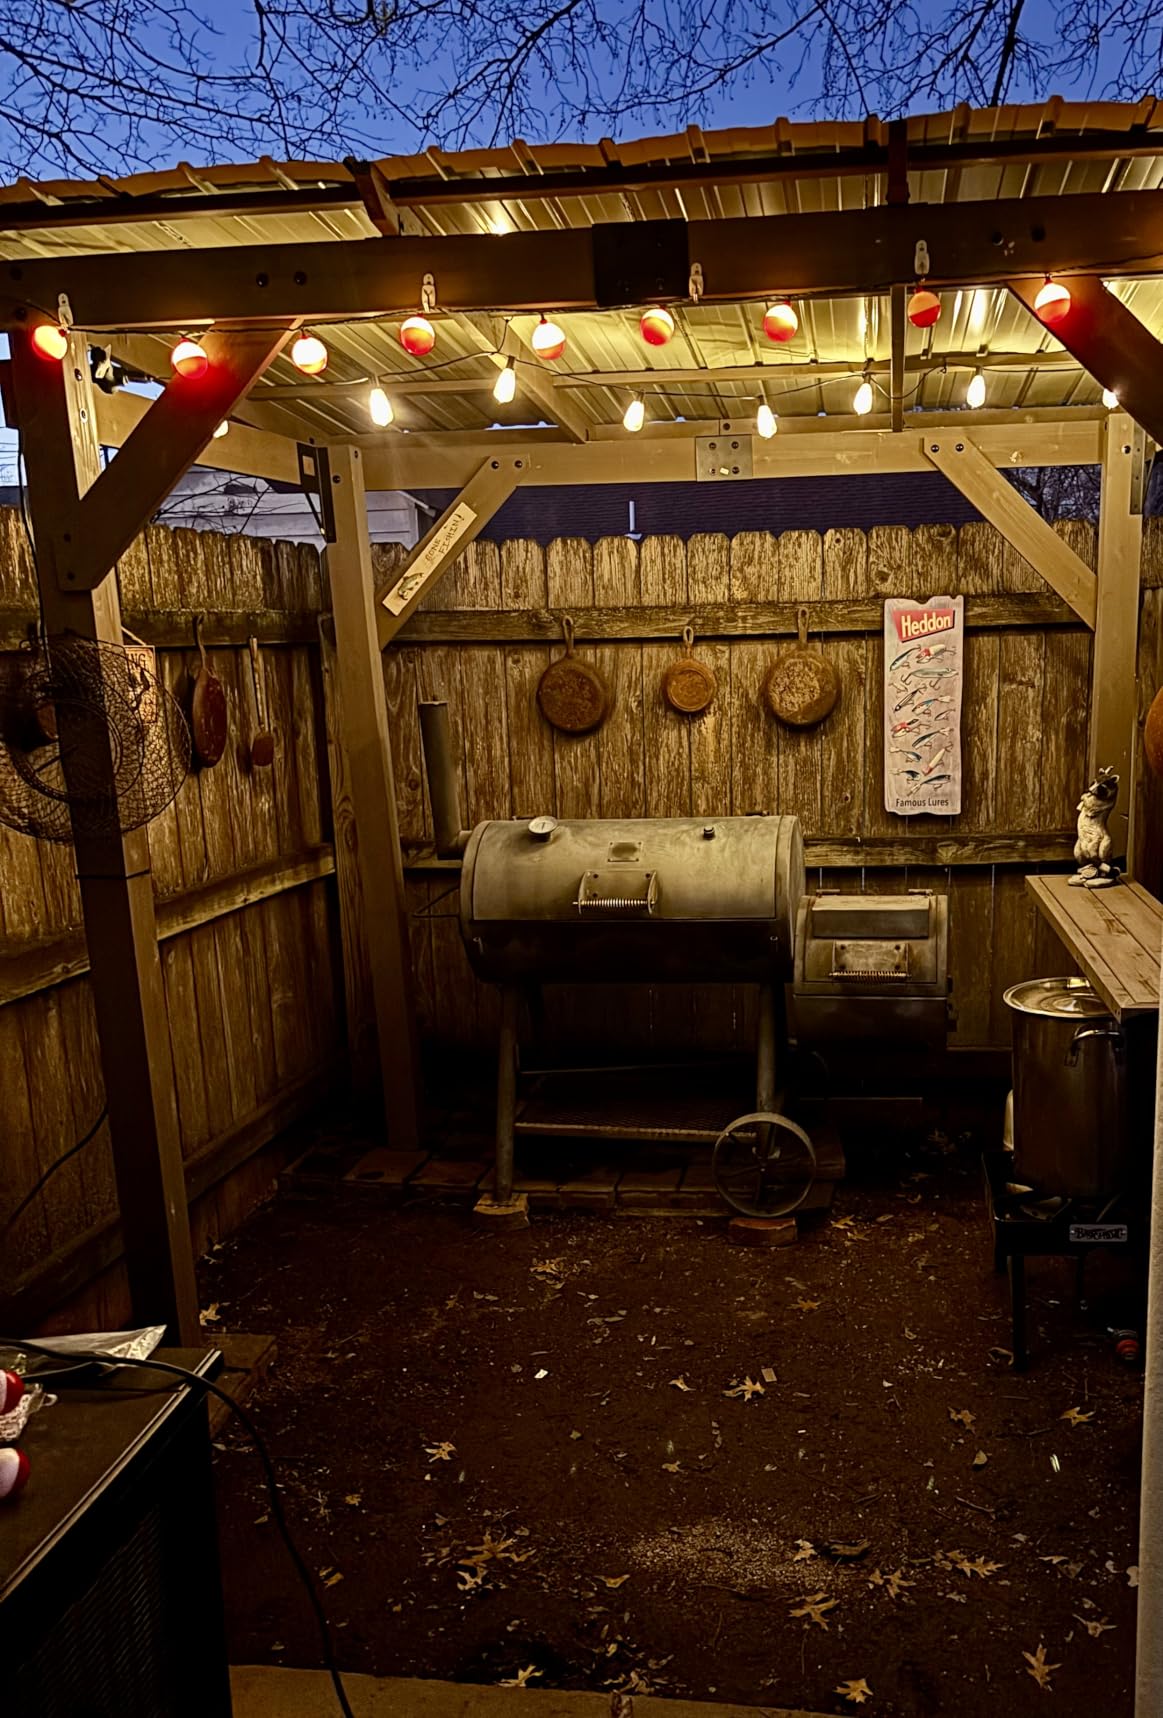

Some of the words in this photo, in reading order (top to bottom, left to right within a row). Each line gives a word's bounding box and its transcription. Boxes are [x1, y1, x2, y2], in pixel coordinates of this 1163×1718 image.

[425, 538, 440, 561] GONE
[901, 611, 951, 638] Heddon
[896, 798, 926, 807] Famous
[927, 797, 949, 807] Lures
